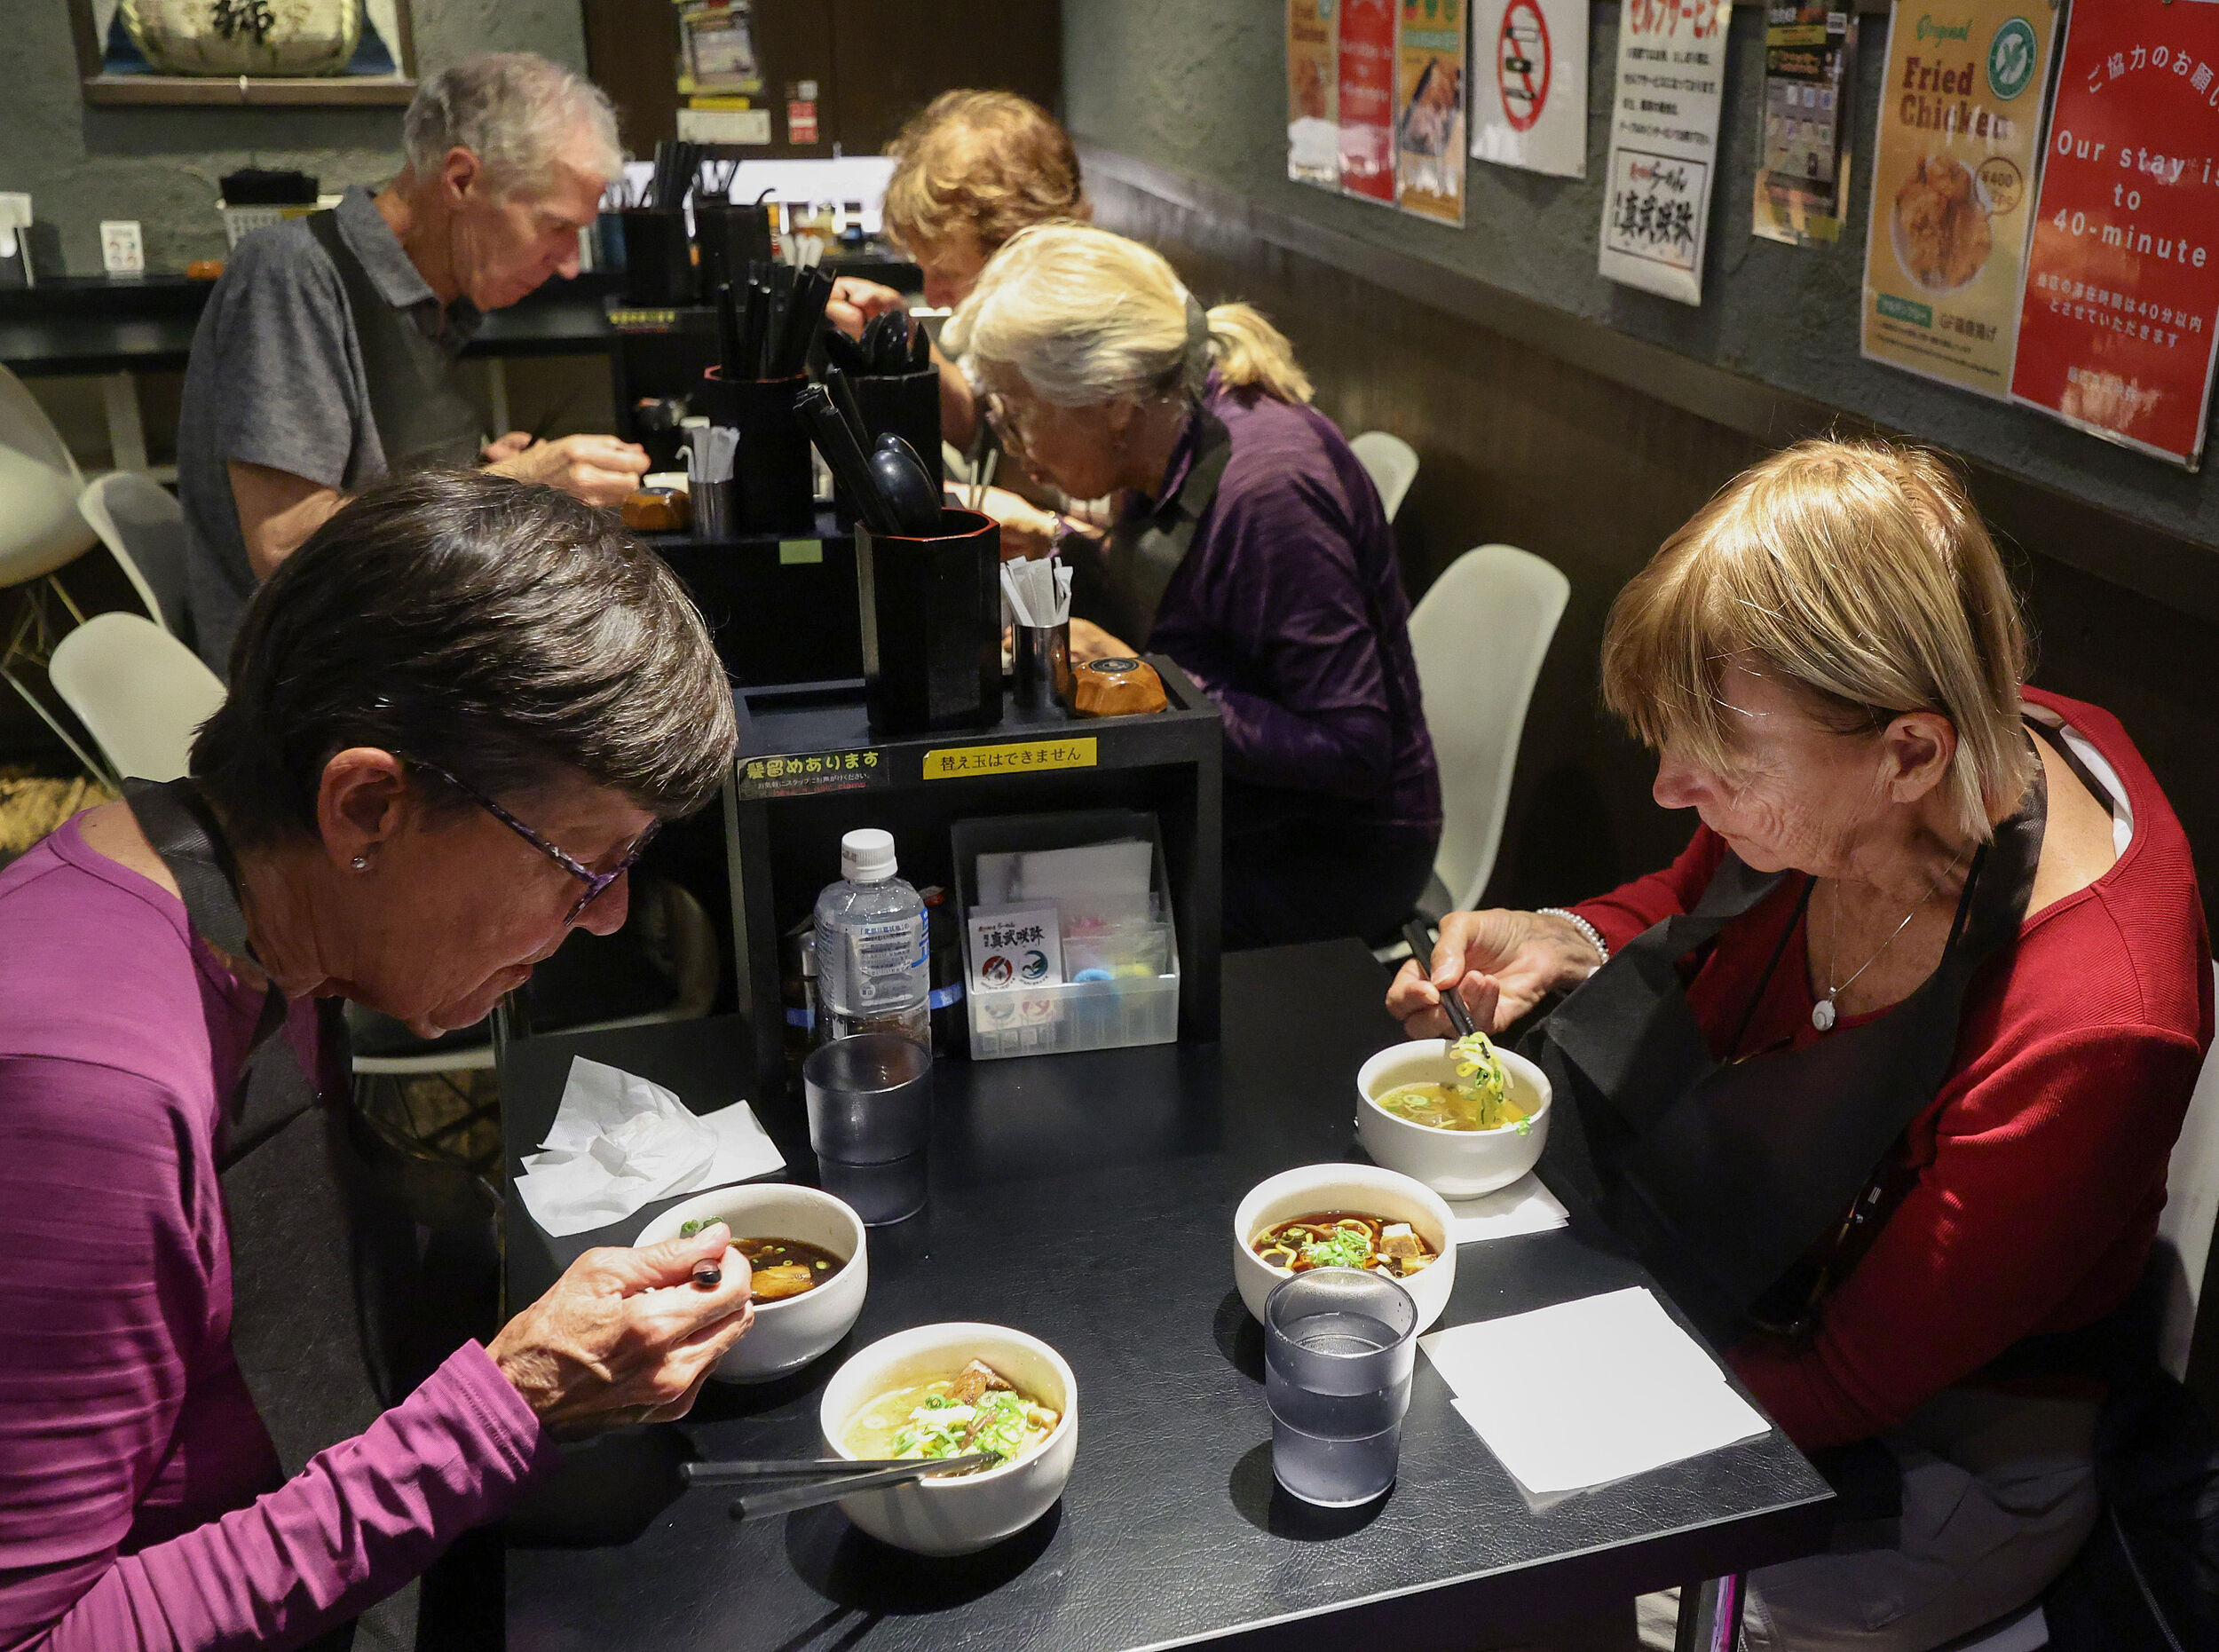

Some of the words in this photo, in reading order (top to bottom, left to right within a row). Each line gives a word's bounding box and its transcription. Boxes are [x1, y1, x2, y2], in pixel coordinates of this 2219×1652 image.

[1902, 57, 1975, 96] Fried
[2057, 130, 2105, 162] Our
[2120, 147, 2184, 183] stay
[2113, 183, 2141, 210] to
[2053, 209, 2207, 267] 40-minute
[746, 751, 879, 779] 髪留めあります
[940, 747, 1081, 771] 替え玉はできません
